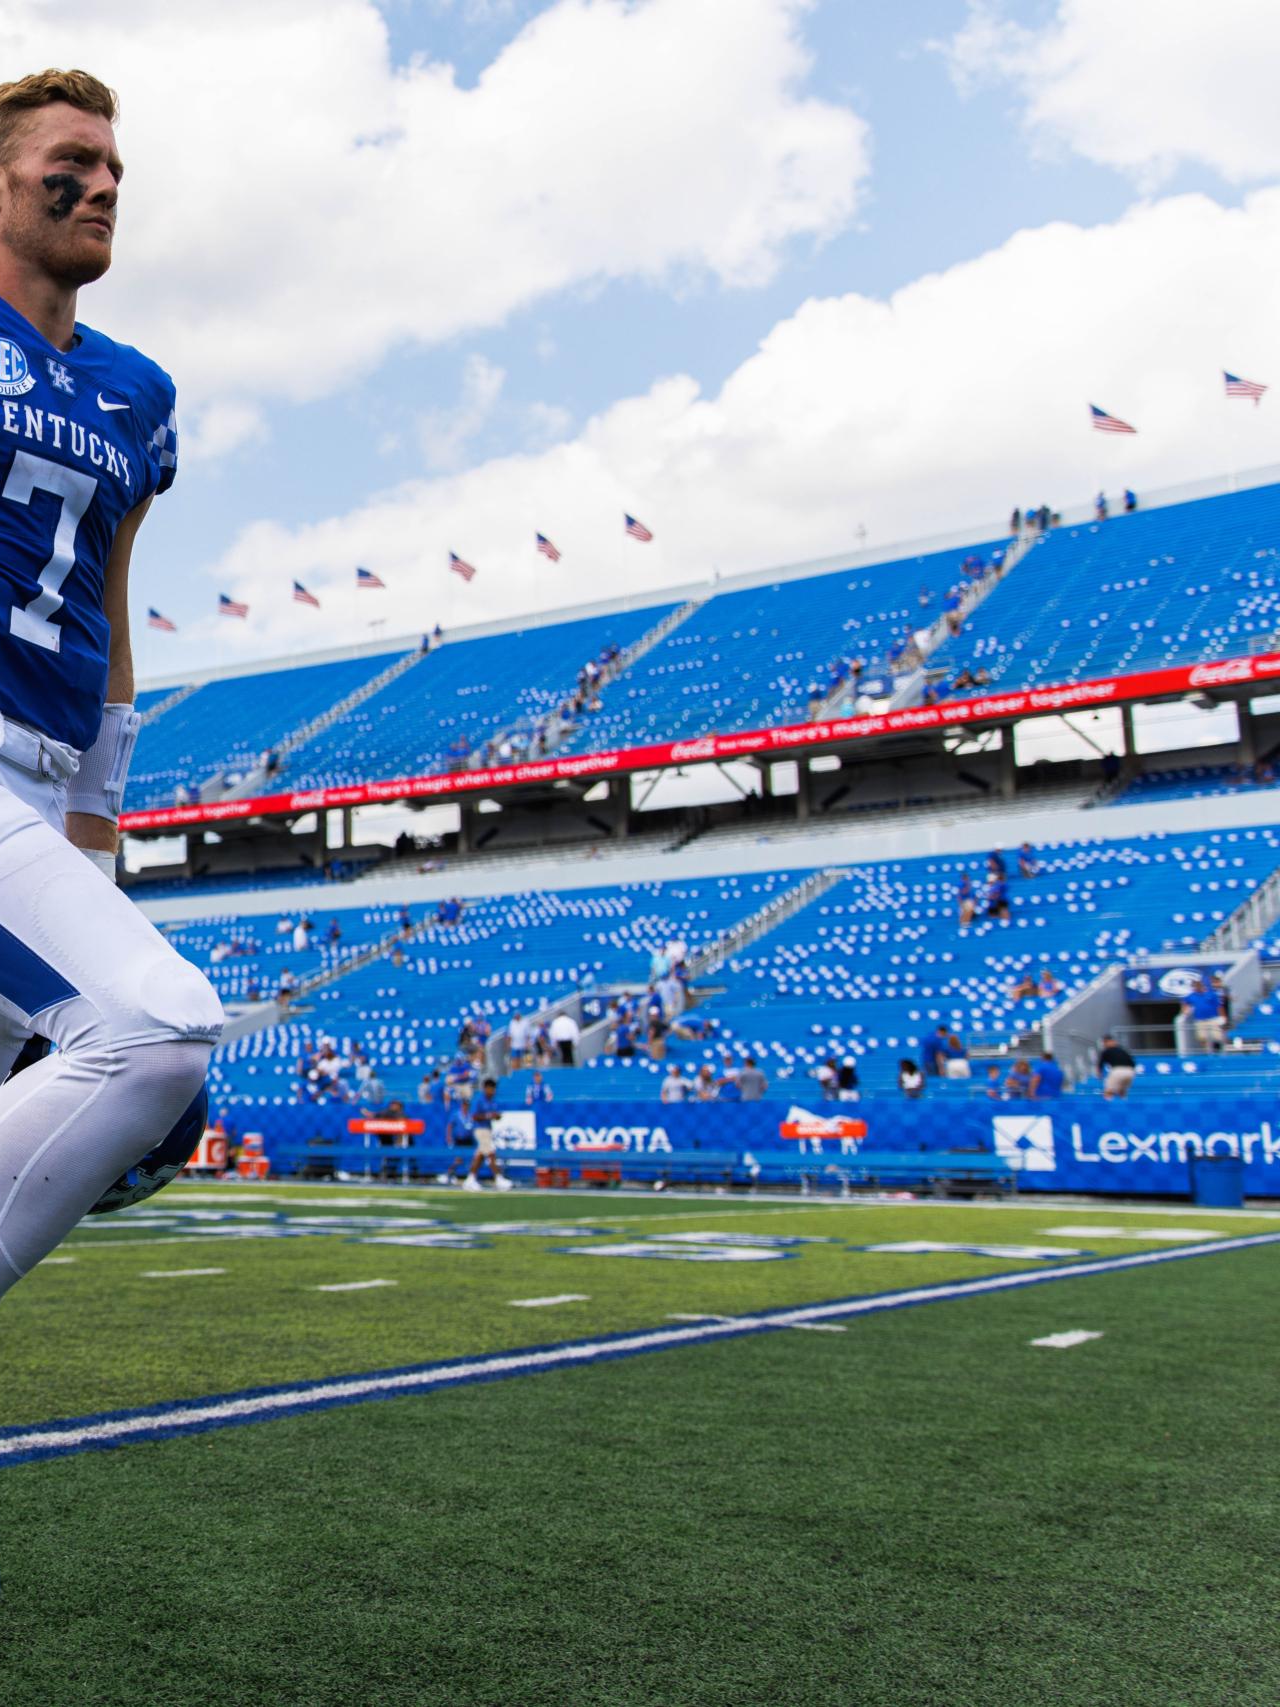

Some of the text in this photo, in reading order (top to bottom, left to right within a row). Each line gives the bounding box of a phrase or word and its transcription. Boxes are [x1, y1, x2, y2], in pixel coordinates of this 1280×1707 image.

[46, 357, 77, 396] UK
[1, 449, 99, 654] 7
[770, 725, 830, 745] There's
[832, 716, 886, 735] magic
[888, 707, 938, 727] when
[941, 706, 969, 721] we
[972, 696, 1025, 716] cheer
[1029, 683, 1118, 708] together
[413, 777, 452, 793] magic
[453, 772, 489, 788] when
[492, 770, 513, 783] we
[515, 763, 555, 780] cheer
[556, 754, 619, 776] together
[544, 1126, 673, 1153] TOYOTA
[1071, 1121, 1280, 1165] Lexmark
